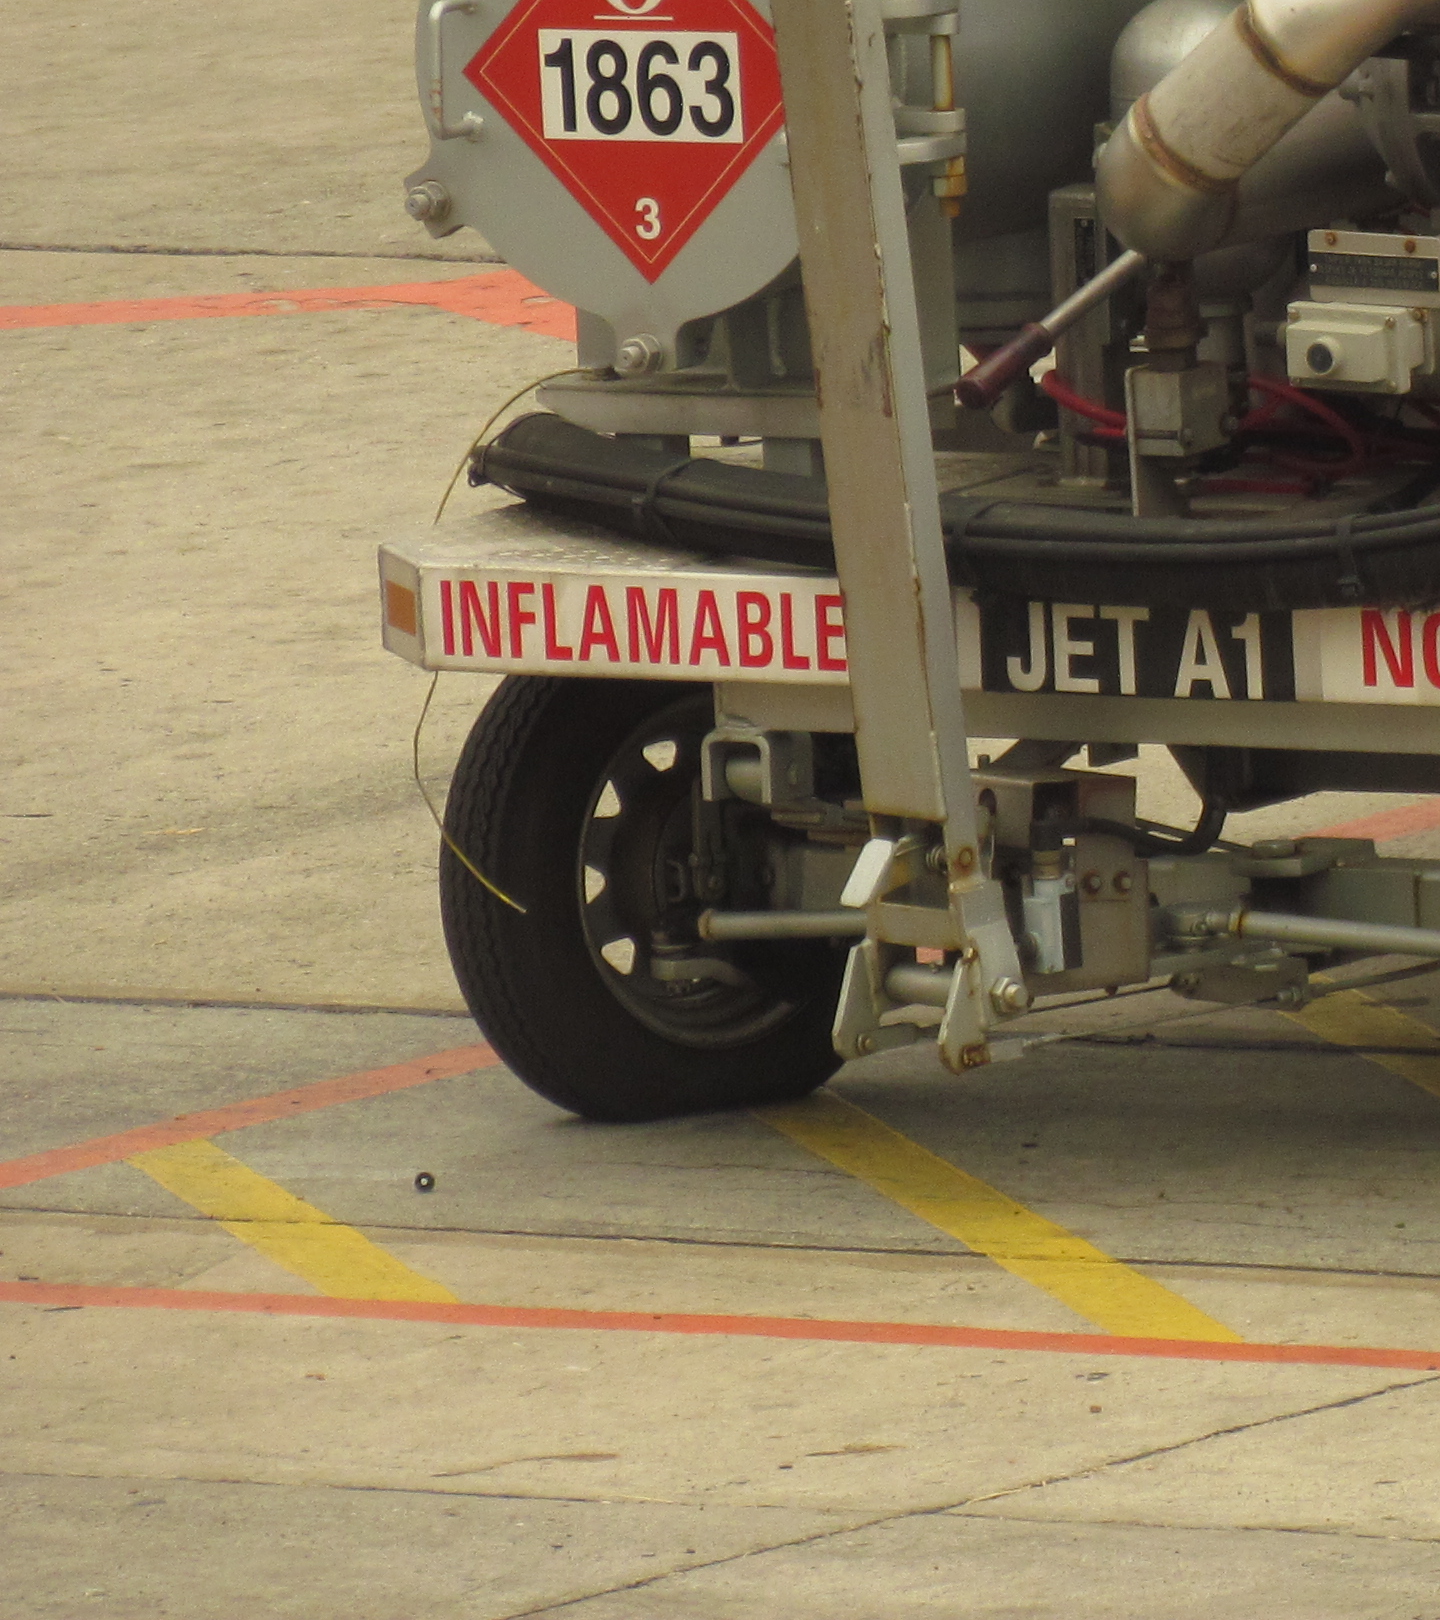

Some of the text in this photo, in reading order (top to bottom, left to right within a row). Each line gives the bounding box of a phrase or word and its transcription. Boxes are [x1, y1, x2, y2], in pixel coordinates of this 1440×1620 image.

[543, 37, 735, 139] 1863
[635, 198, 661, 240] 3
[441, 580, 848, 672] INFLAMABLE
[1006, 601, 1265, 701] JET A1
